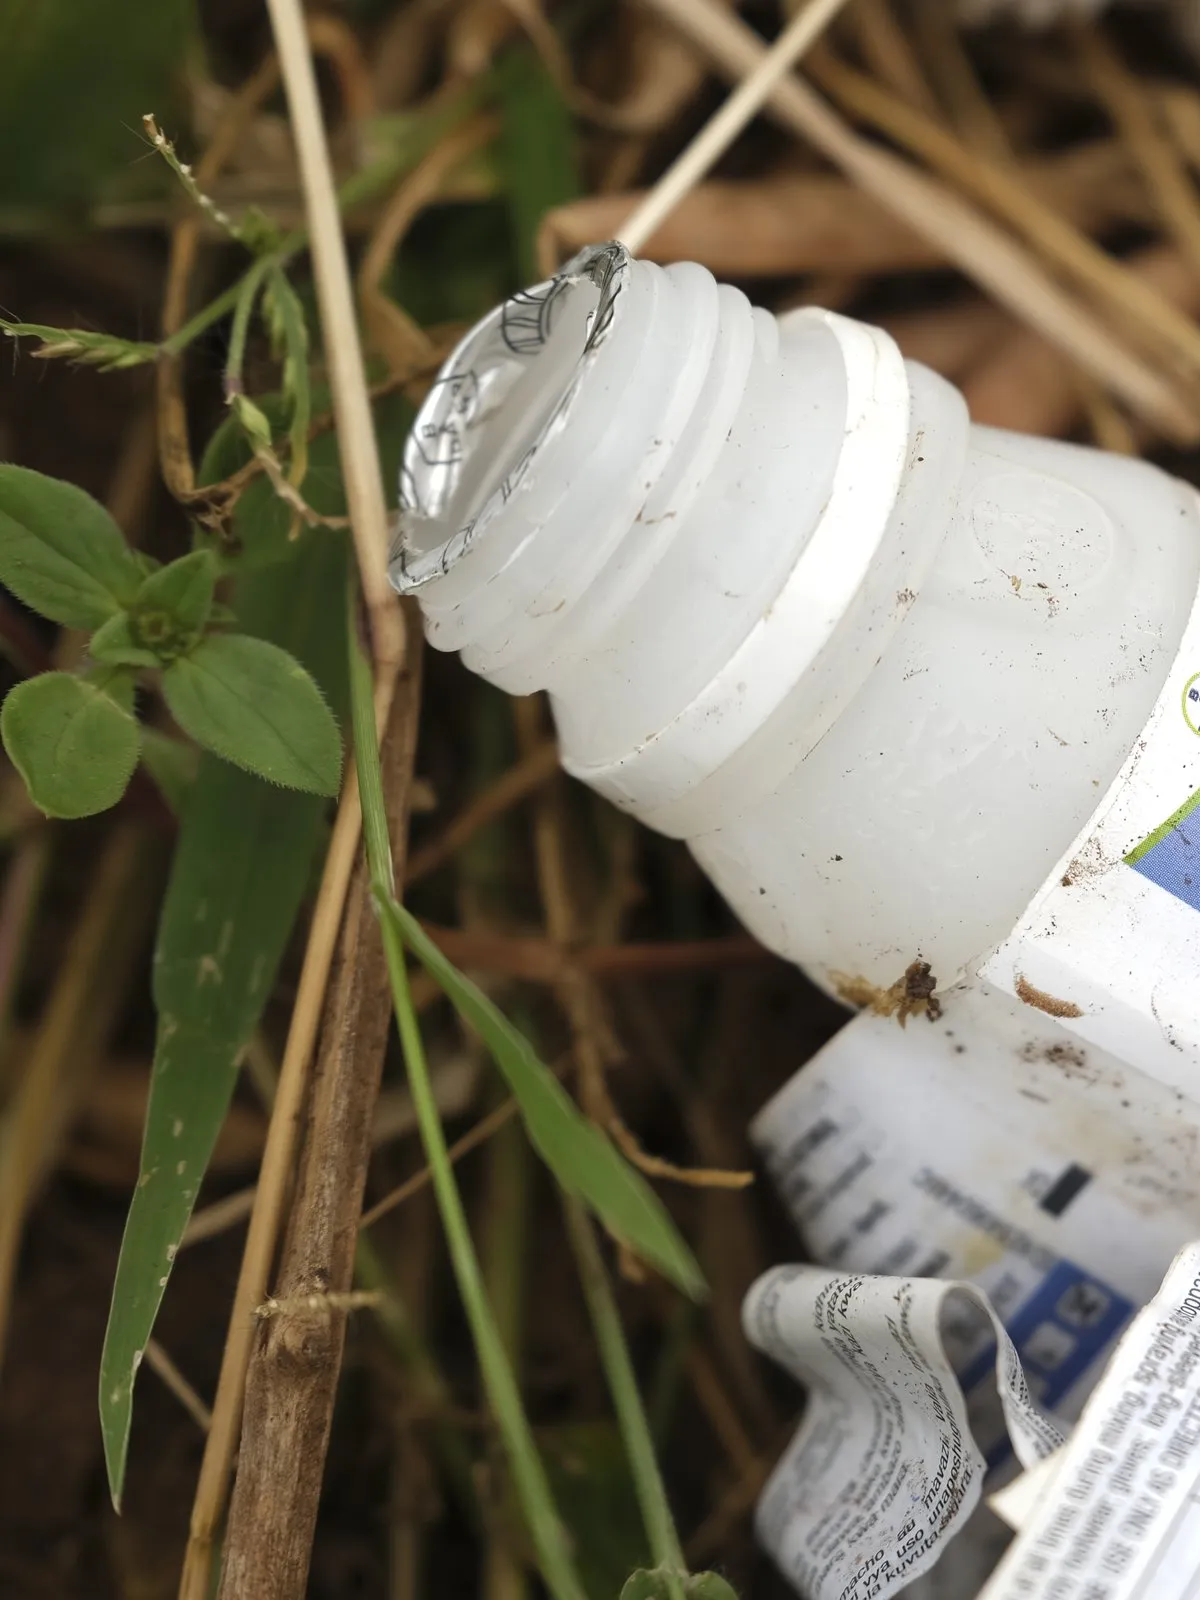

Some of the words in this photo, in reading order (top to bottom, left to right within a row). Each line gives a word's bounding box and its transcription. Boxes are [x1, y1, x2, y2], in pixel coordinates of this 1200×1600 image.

[863, 1560, 890, 1587] vya
[896, 1529, 924, 1558] uso
[886, 1531, 938, 1582] kuvuta
